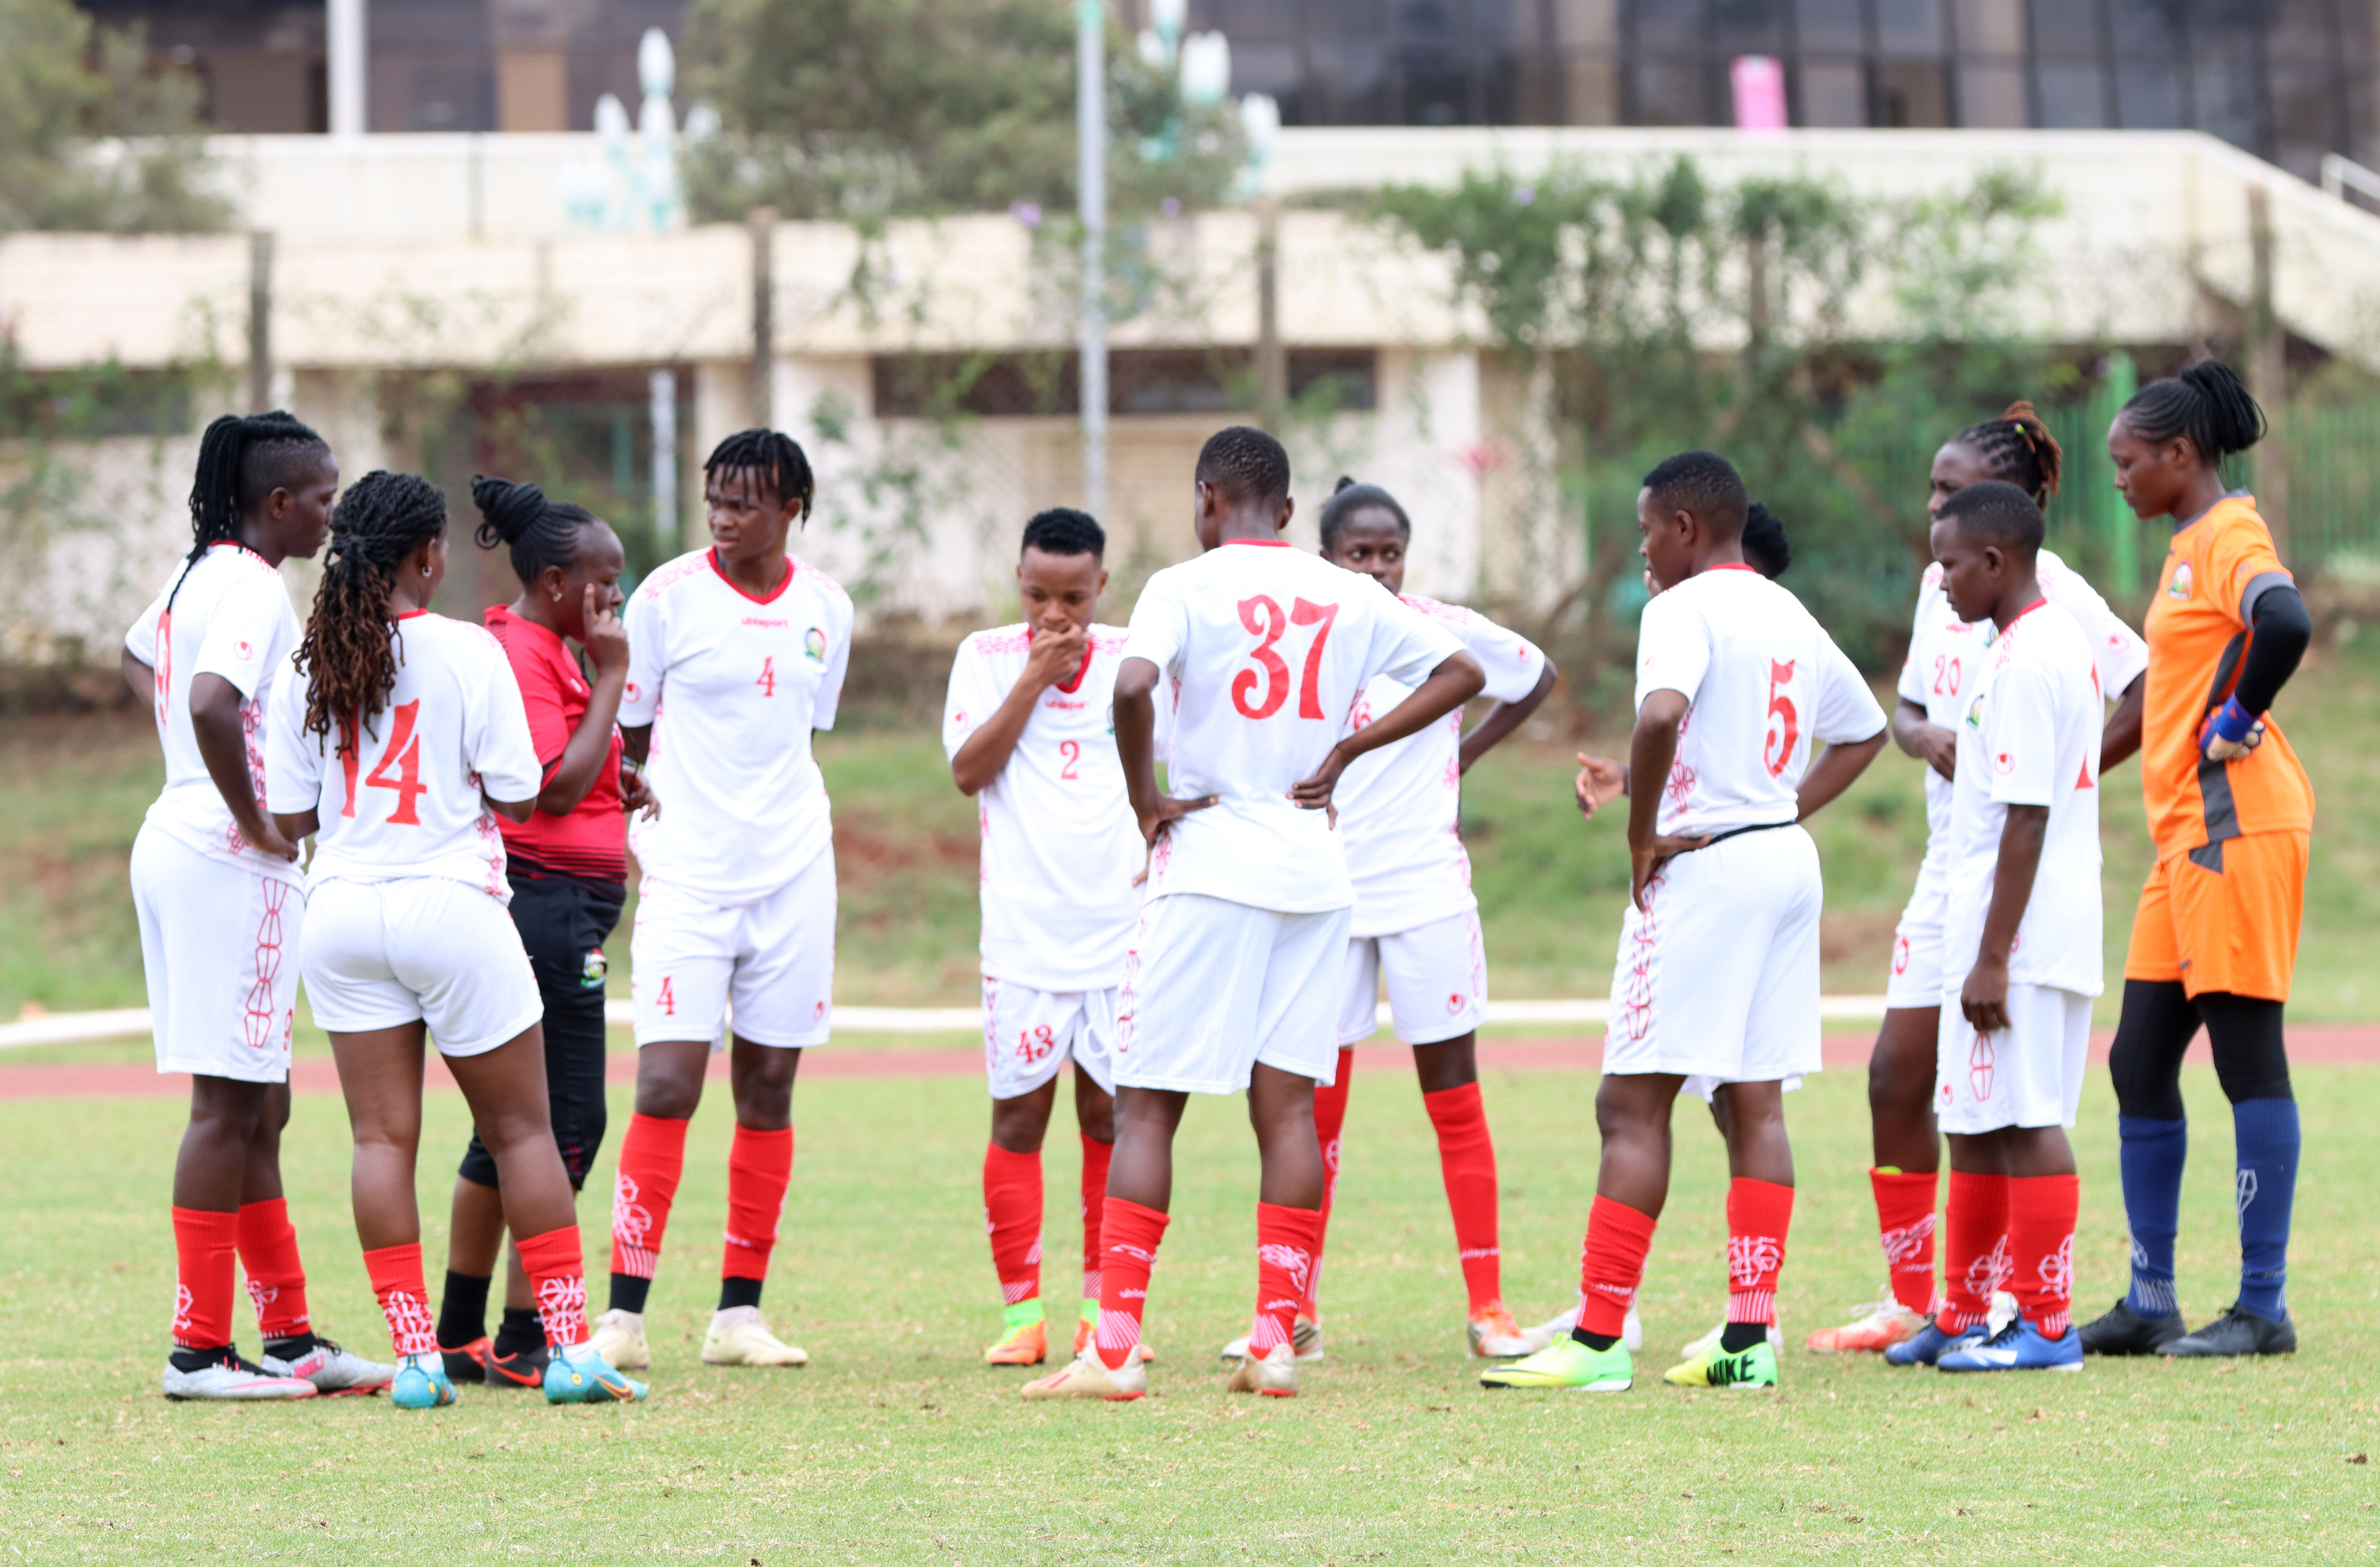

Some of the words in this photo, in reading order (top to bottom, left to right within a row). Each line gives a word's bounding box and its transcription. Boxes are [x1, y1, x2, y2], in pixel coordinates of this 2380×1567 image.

[756, 656, 776, 697] 4
[1232, 594, 1339, 720] 37
[1934, 654, 1961, 697] 20
[1764, 659, 1799, 779] 5
[341, 698, 427, 826] 14
[1059, 740, 1081, 780] 2
[656, 976, 676, 1016] 4
[1016, 1024, 1054, 1065] 43
[1707, 1353, 1755, 1386] NIKE
